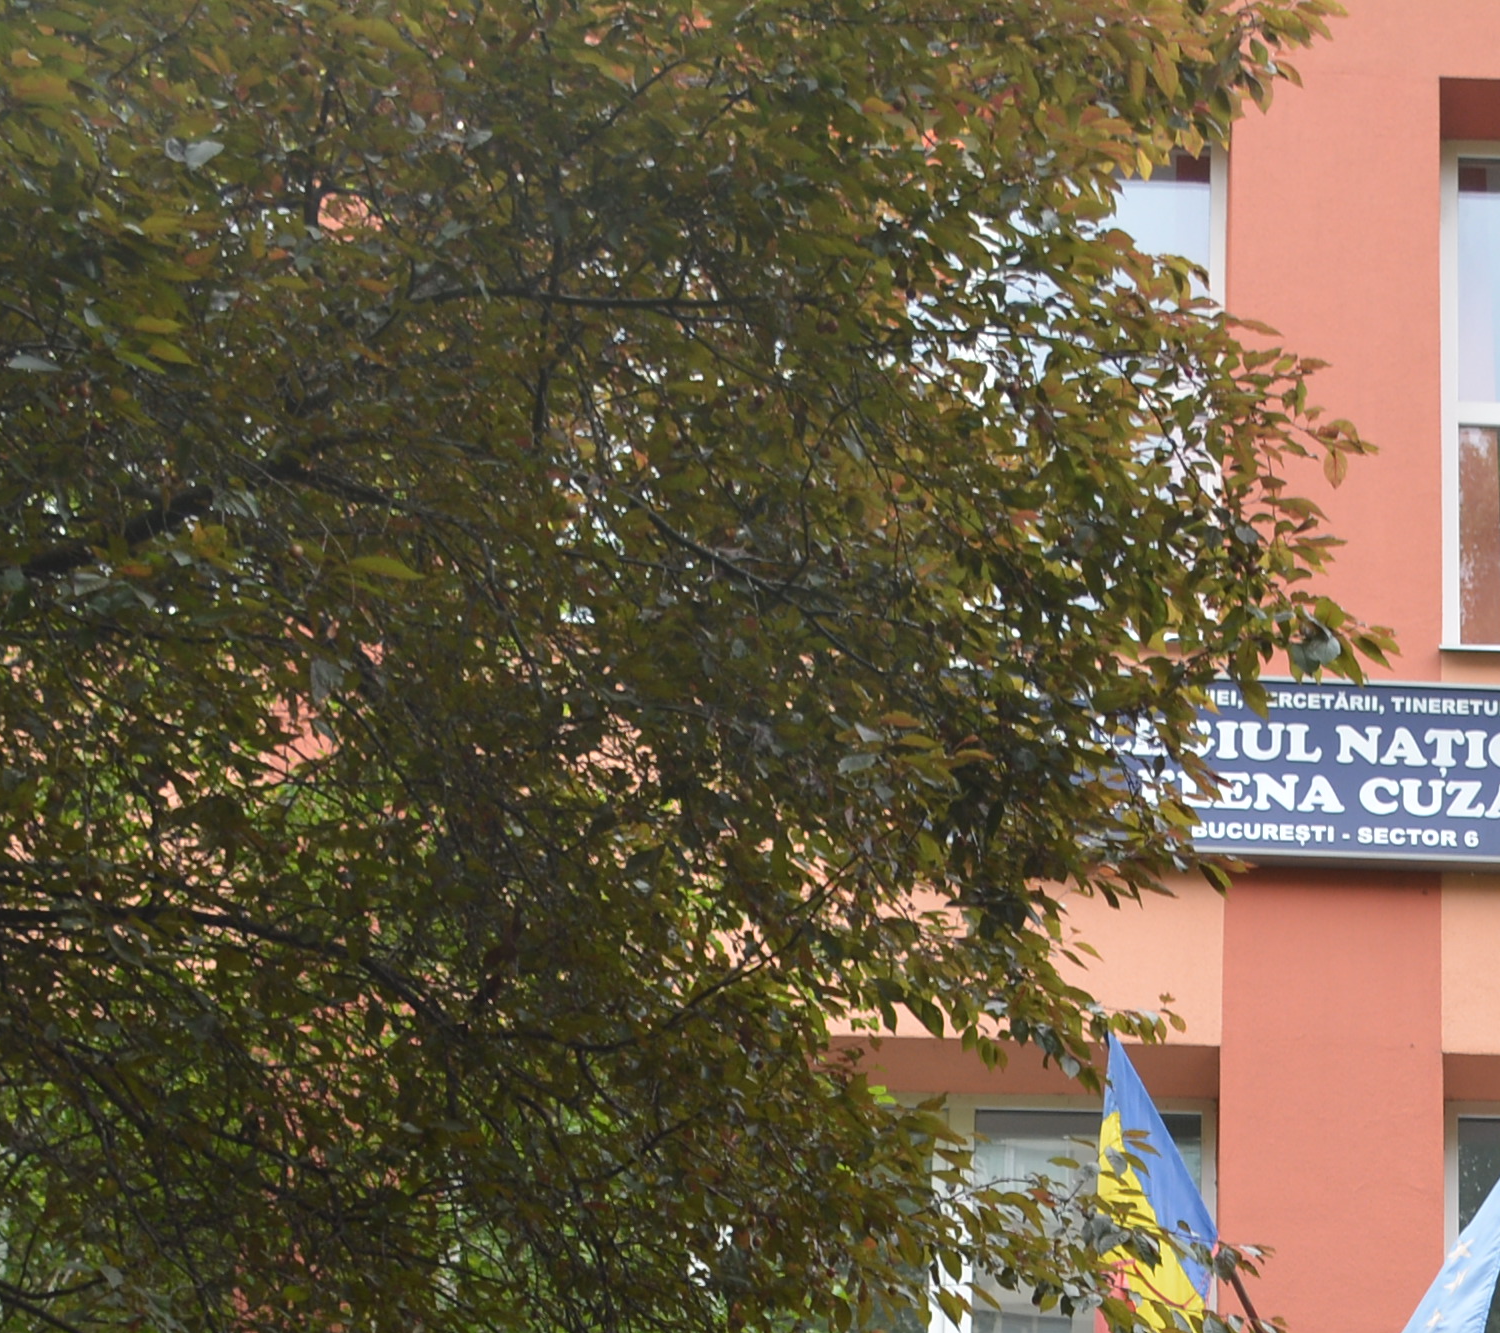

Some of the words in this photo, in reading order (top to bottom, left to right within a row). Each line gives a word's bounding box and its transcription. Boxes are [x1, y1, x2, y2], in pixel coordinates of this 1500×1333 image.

[1265, 691, 1385, 714] ERCETĂRII,
[1190, 820, 1335, 847] BUCUREȘTI
[1357, 826, 1458, 847] SECTOR
[1463, 830, 1479, 848] 6
